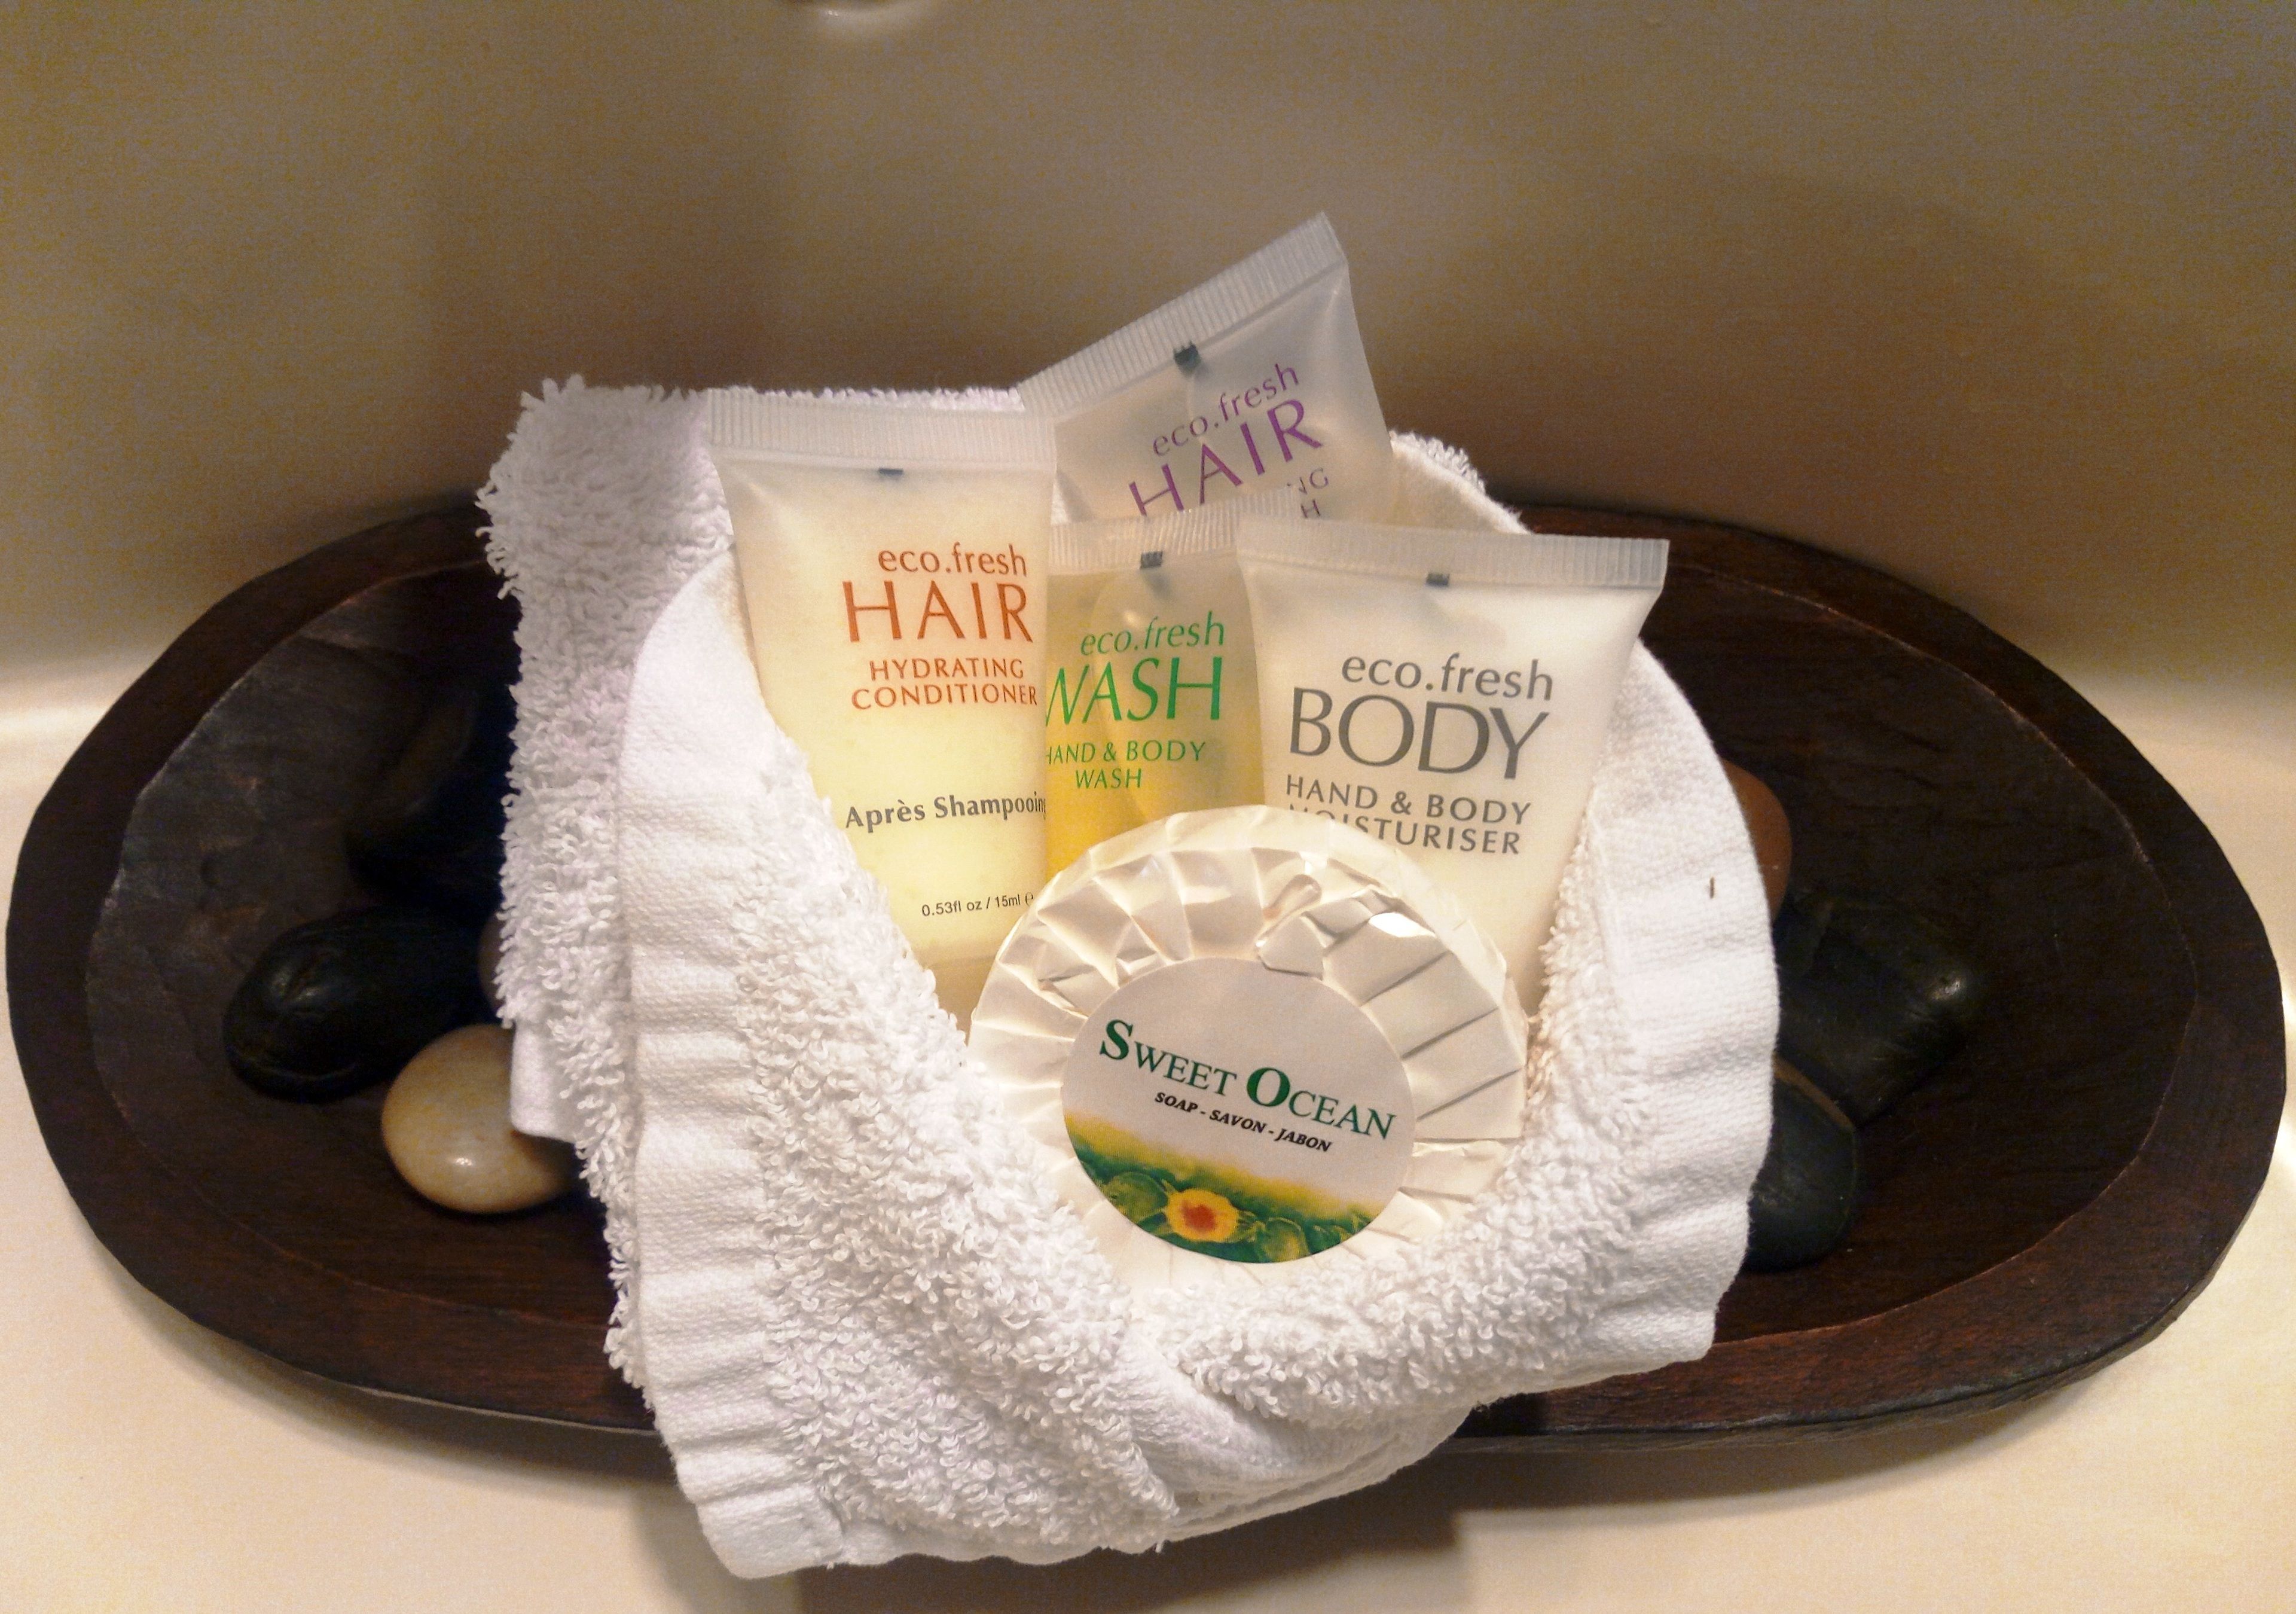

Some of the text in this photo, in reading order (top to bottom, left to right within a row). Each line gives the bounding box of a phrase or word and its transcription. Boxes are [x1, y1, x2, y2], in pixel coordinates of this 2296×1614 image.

[1152, 364, 1299, 456] eco.fresh
[1129, 398, 1323, 516] HAIR
[878, 541, 1027, 577] eco.fresh
[842, 580, 1033, 642] HAIR
[1080, 610, 1225, 656] eco.fresh
[870, 657, 1024, 681] HYDRATING
[1341, 652, 1553, 701] eco.fresh
[851, 684, 1037, 710] CONDITIONER
[1103, 742, 1117, 762] &
[1126, 740, 1206, 761] BODY
[1290, 687, 1549, 780] BODY
[1076, 768, 1142, 789] WASH
[1286, 774, 1531, 825] HAND & BODY
[845, 799, 926, 833] Après
[1290, 803, 1521, 855] STURISER
[922, 900, 961, 917] 0.53fl
[966, 899, 982, 911] oz
[986, 897, 991, 909] /
[995, 893, 1020, 908] 15ml
[1099, 1019, 1397, 1140] SWEET OCEAN
[1155, 1091, 1198, 1114] SOAP
[1209, 1109, 1267, 1134] SAVON
[1274, 1127, 1333, 1152] JABON
